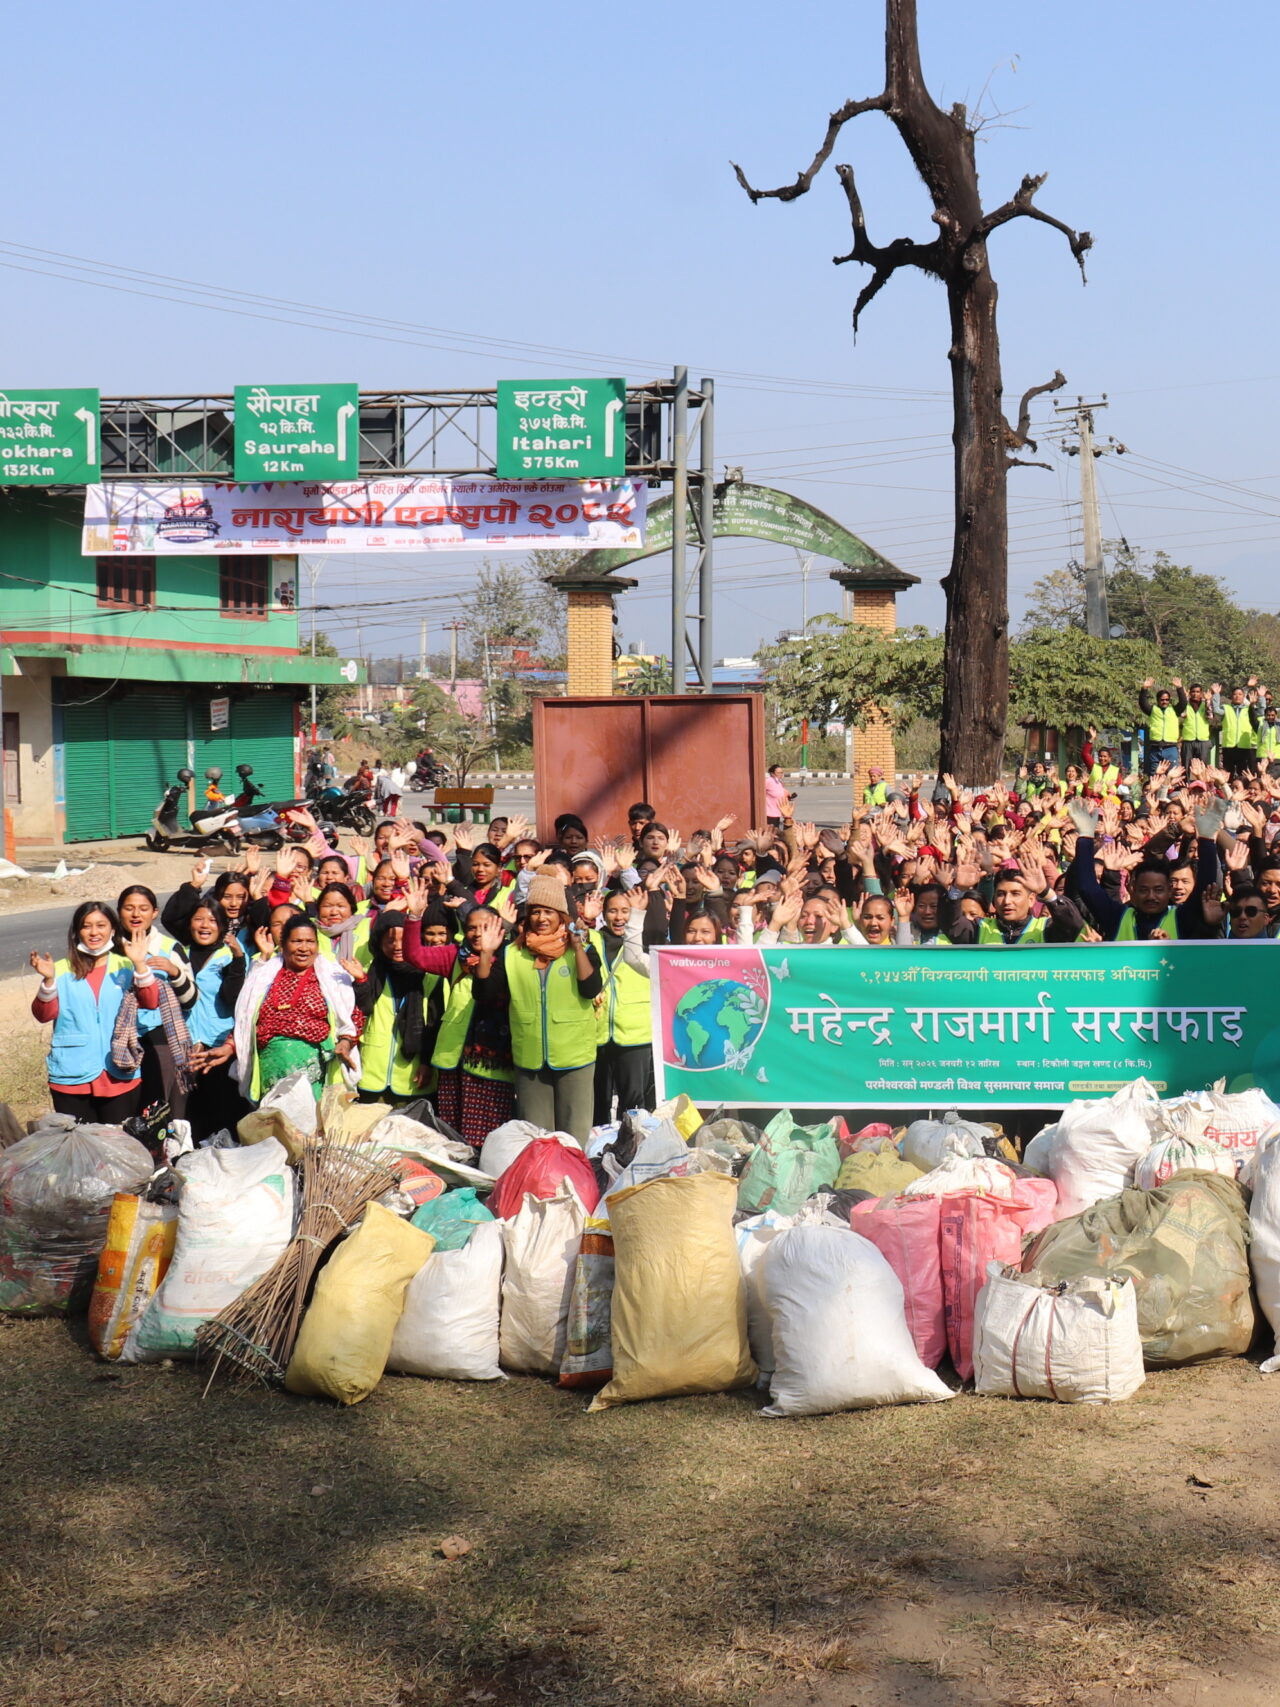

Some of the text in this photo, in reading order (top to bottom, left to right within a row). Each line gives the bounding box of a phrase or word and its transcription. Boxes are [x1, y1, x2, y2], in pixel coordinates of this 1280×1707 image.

[246, 388, 321, 417] सौराहा
[513, 385, 588, 411] इटहरी
[244, 440, 336, 455] Sauraha
[513, 435, 592, 450] Itahari
[0, 444, 73, 459] okhara
[3, 463, 55, 477] 132Km
[522, 456, 580, 469] 375Km
[232, 501, 388, 535] नारायणी
[394, 498, 521, 529] एक्सपो
[528, 503, 634, 529] २०८२
[761, 520, 794, 533] COMMUNITY
[669, 957, 730, 969] watv.org/ne
[921, 966, 989, 982] विश्वव्यापी
[992, 969, 1048, 982] वातावरण
[1051, 969, 1106, 982] सरसफाइ
[1110, 966, 1161, 982] अभियान
[785, 991, 1248, 1048] महेन्द्र राजमार्ग सरसफाइ
[940, 1058, 963, 1067] जनवरी
[865, 1077, 1065, 1094] परमेश्वरको मण्डली विश्व सुसमाचार समाज
